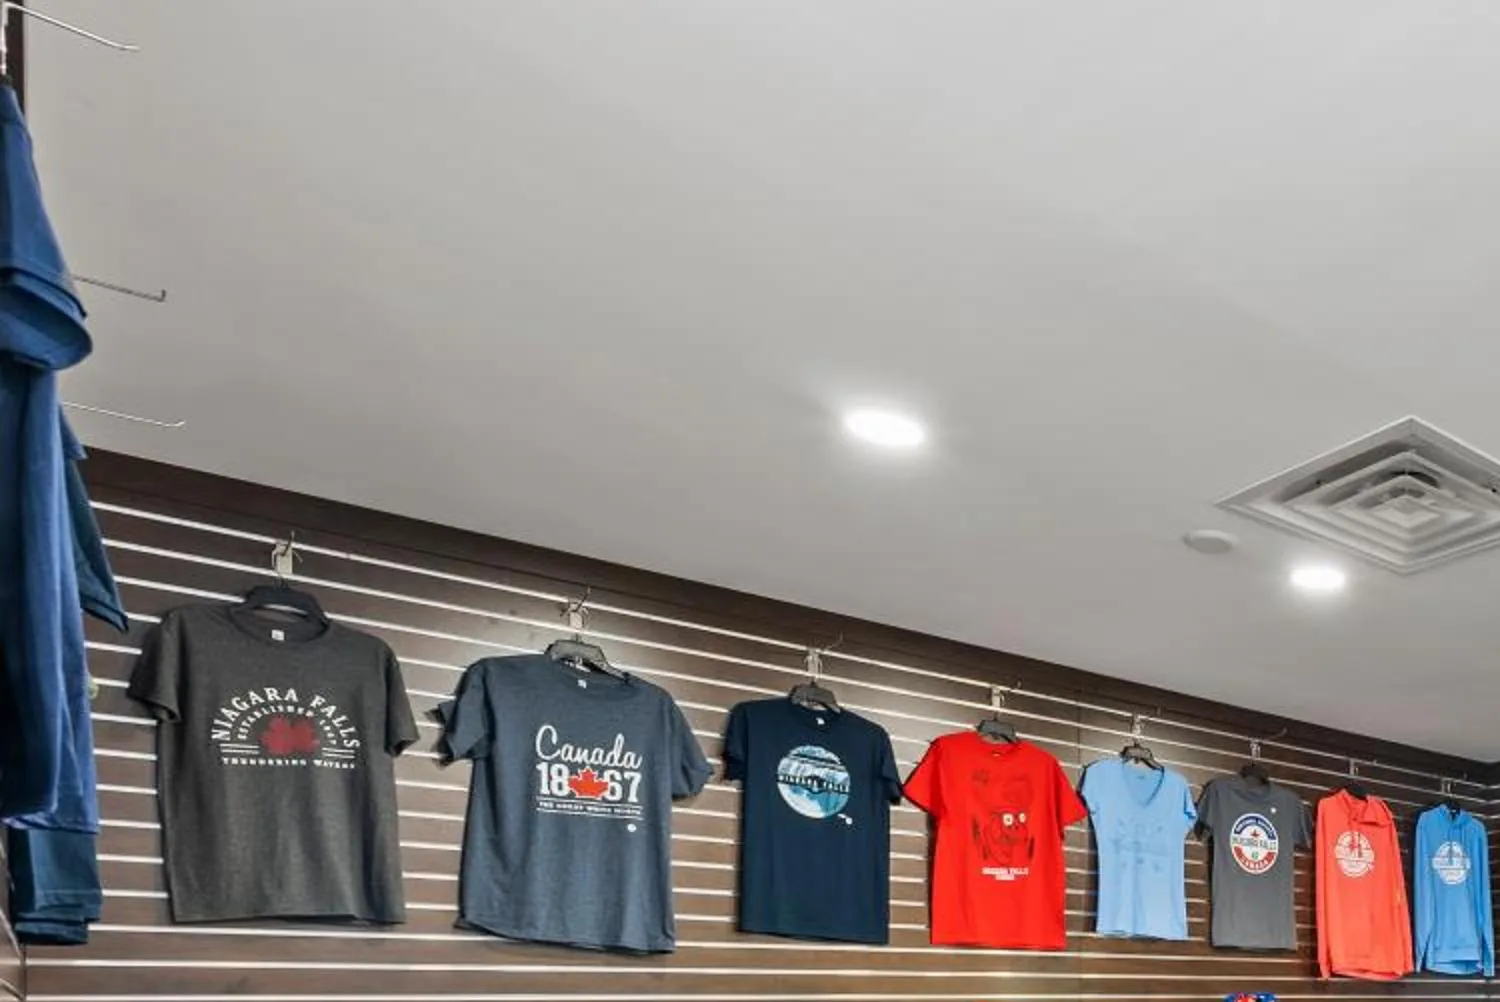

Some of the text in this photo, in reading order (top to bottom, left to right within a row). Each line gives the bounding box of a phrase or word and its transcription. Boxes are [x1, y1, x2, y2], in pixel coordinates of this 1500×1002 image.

[211, 687, 360, 748] NIAGARA FALLS
[535, 724, 643, 769] Canada
